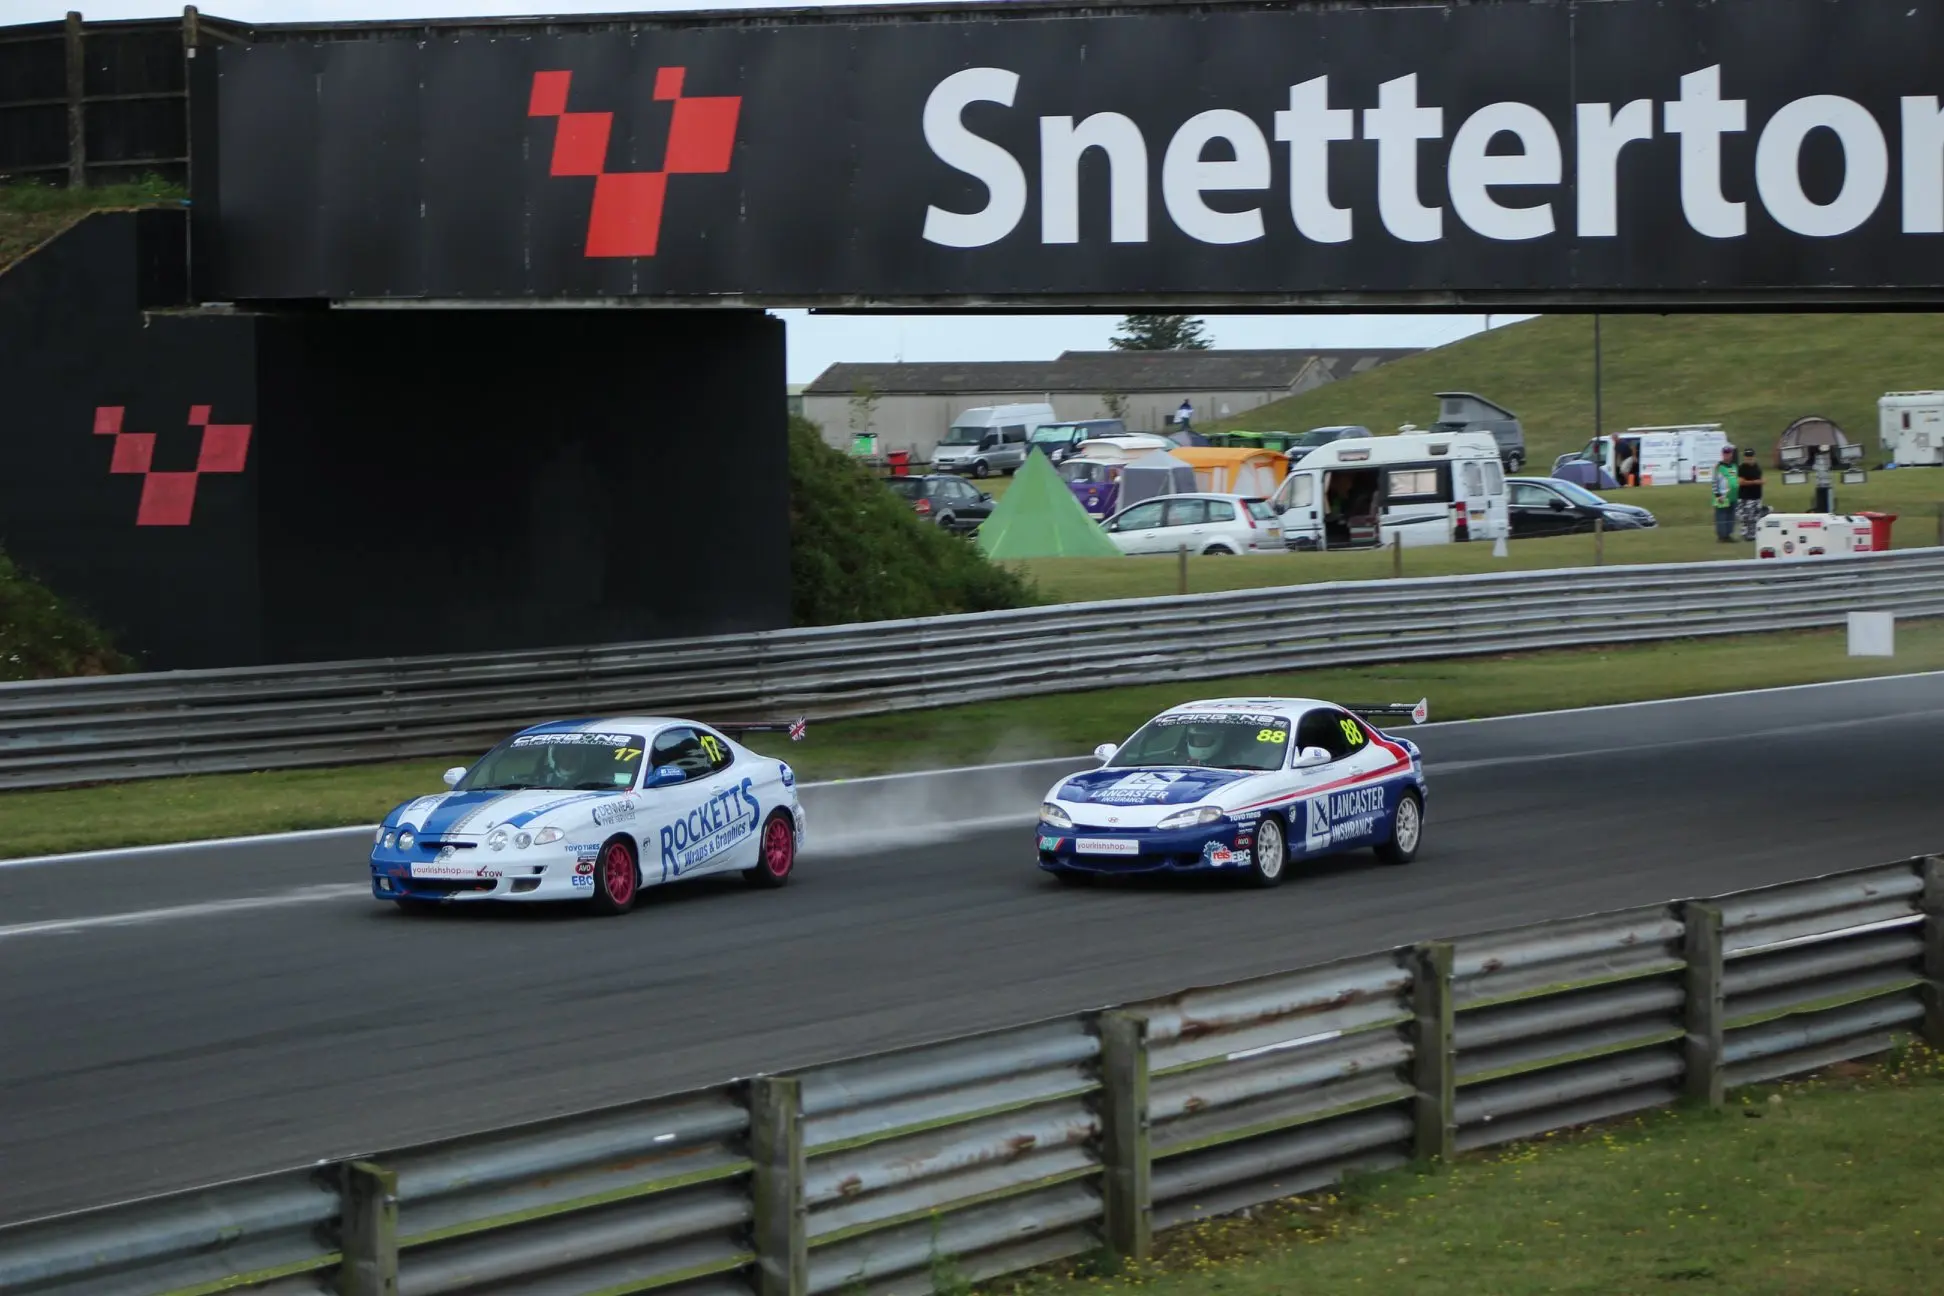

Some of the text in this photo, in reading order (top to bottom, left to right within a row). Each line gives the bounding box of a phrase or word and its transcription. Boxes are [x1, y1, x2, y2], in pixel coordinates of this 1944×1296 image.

[1256, 729, 1286, 744] 88
[1339, 718, 1364, 745] 88
[614, 747, 642, 762] 17
[700, 735, 722, 762] 17
[1089, 789, 1170, 799] LANCASTER
[1100, 796, 1148, 804] INSURANCE
[1331, 786, 1385, 820] LANCASTER
[660, 777, 761, 883] ROCKETTS
[1331, 816, 1375, 843] INSURANCE
[565, 843, 600, 852] TOYO TIRES
[684, 842, 709, 868] Wraps
[715, 820, 746, 848] Graphics
[1212, 849, 1231, 860] reis
[1231, 849, 1251, 863] EBC
[484, 870, 503, 878] TOW
[572, 876, 594, 886] EBC
